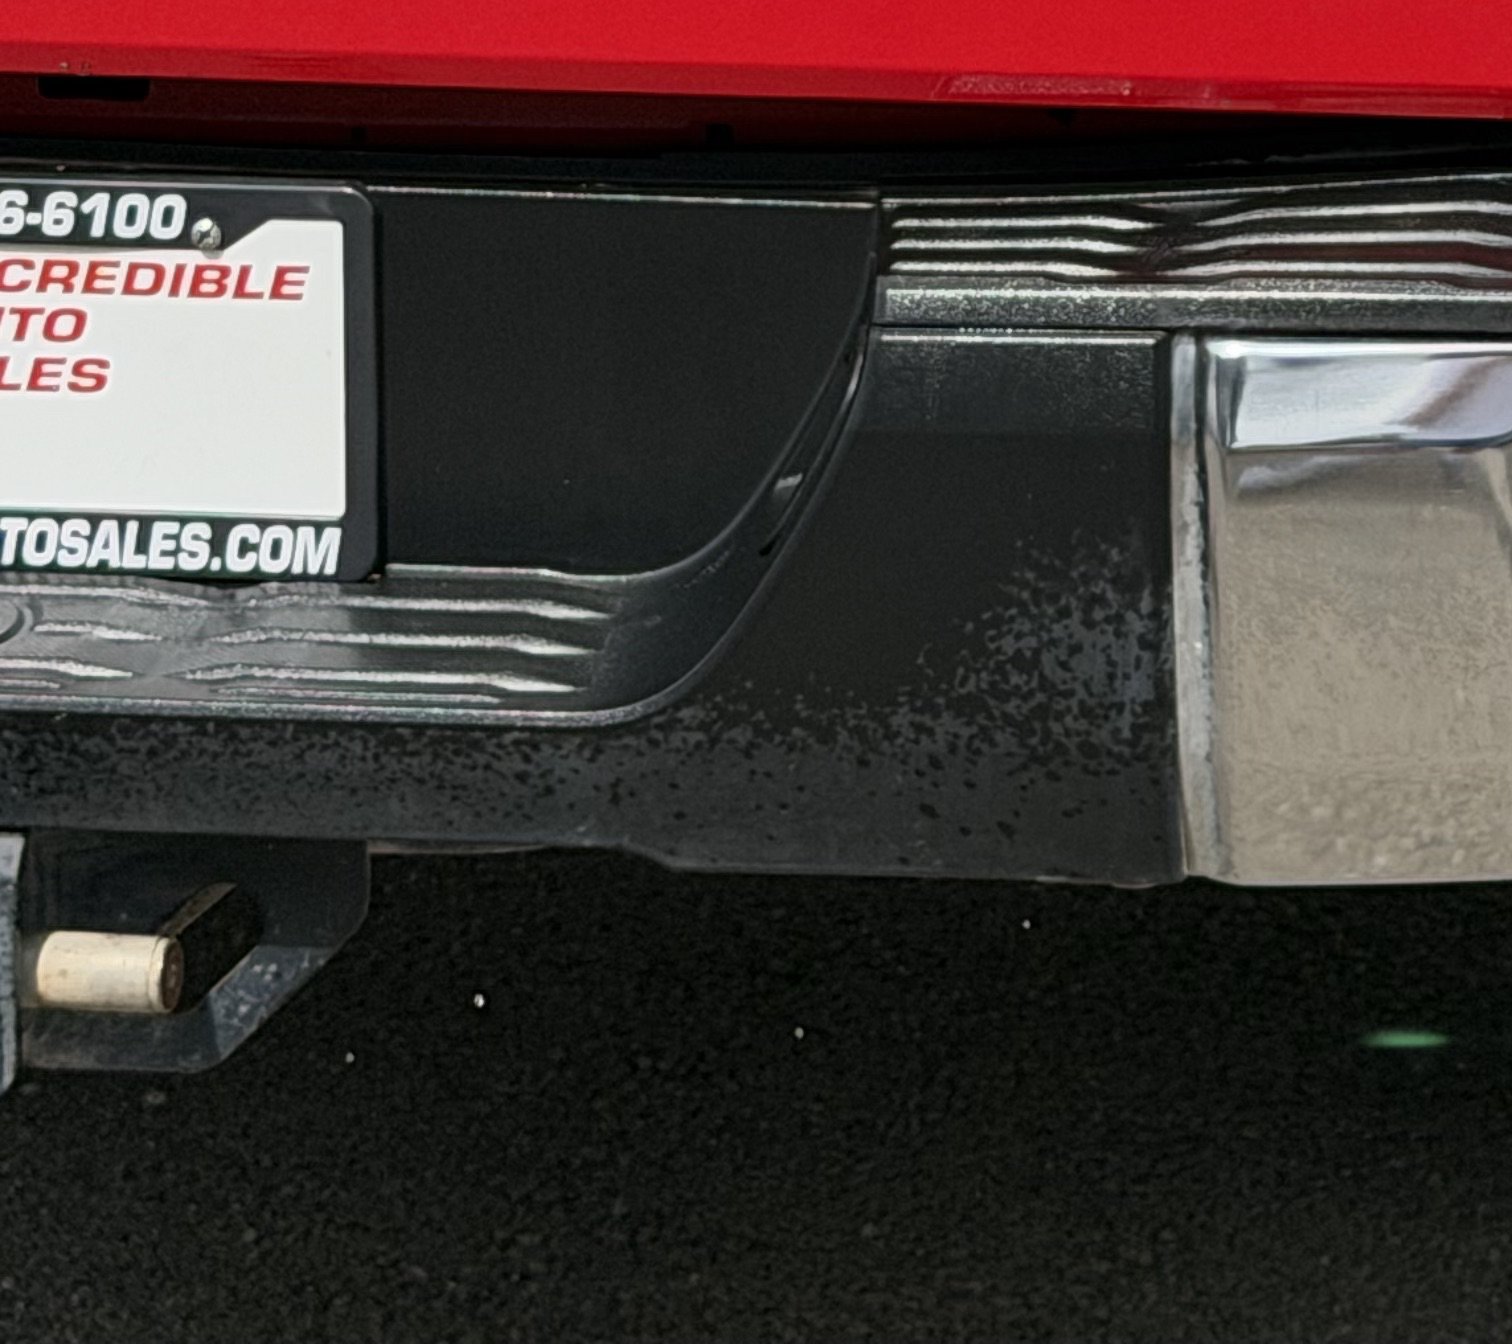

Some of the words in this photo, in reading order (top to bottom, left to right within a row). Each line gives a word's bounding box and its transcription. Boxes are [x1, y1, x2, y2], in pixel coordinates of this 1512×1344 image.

[0, 189, 188, 240] 6-6100
[0, 258, 311, 301] CREDIBLE
[0, 306, 89, 343] TO
[0, 516, 342, 576] TOSALES.COM
